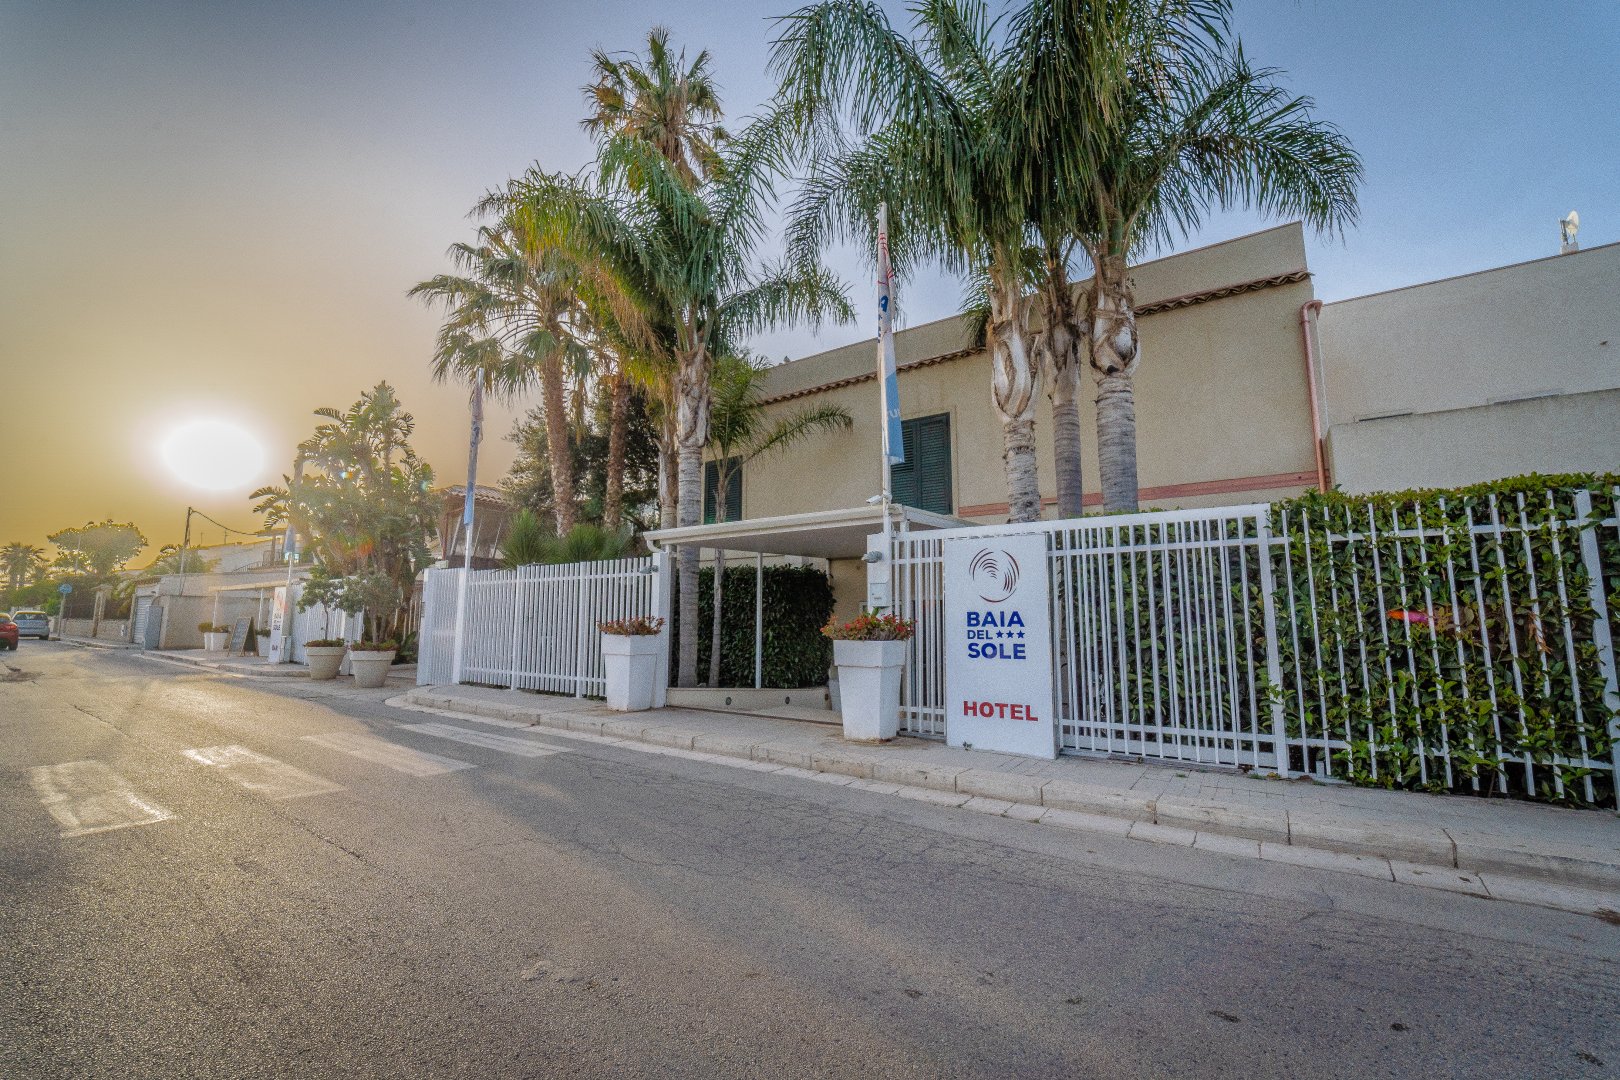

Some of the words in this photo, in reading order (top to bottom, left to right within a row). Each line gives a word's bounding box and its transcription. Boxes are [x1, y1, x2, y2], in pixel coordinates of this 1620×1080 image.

[966, 610, 1025, 628] BAIA
[967, 629, 993, 640] DEL
[967, 642, 1027, 660] SOLE
[963, 700, 1039, 722] HOTEL
